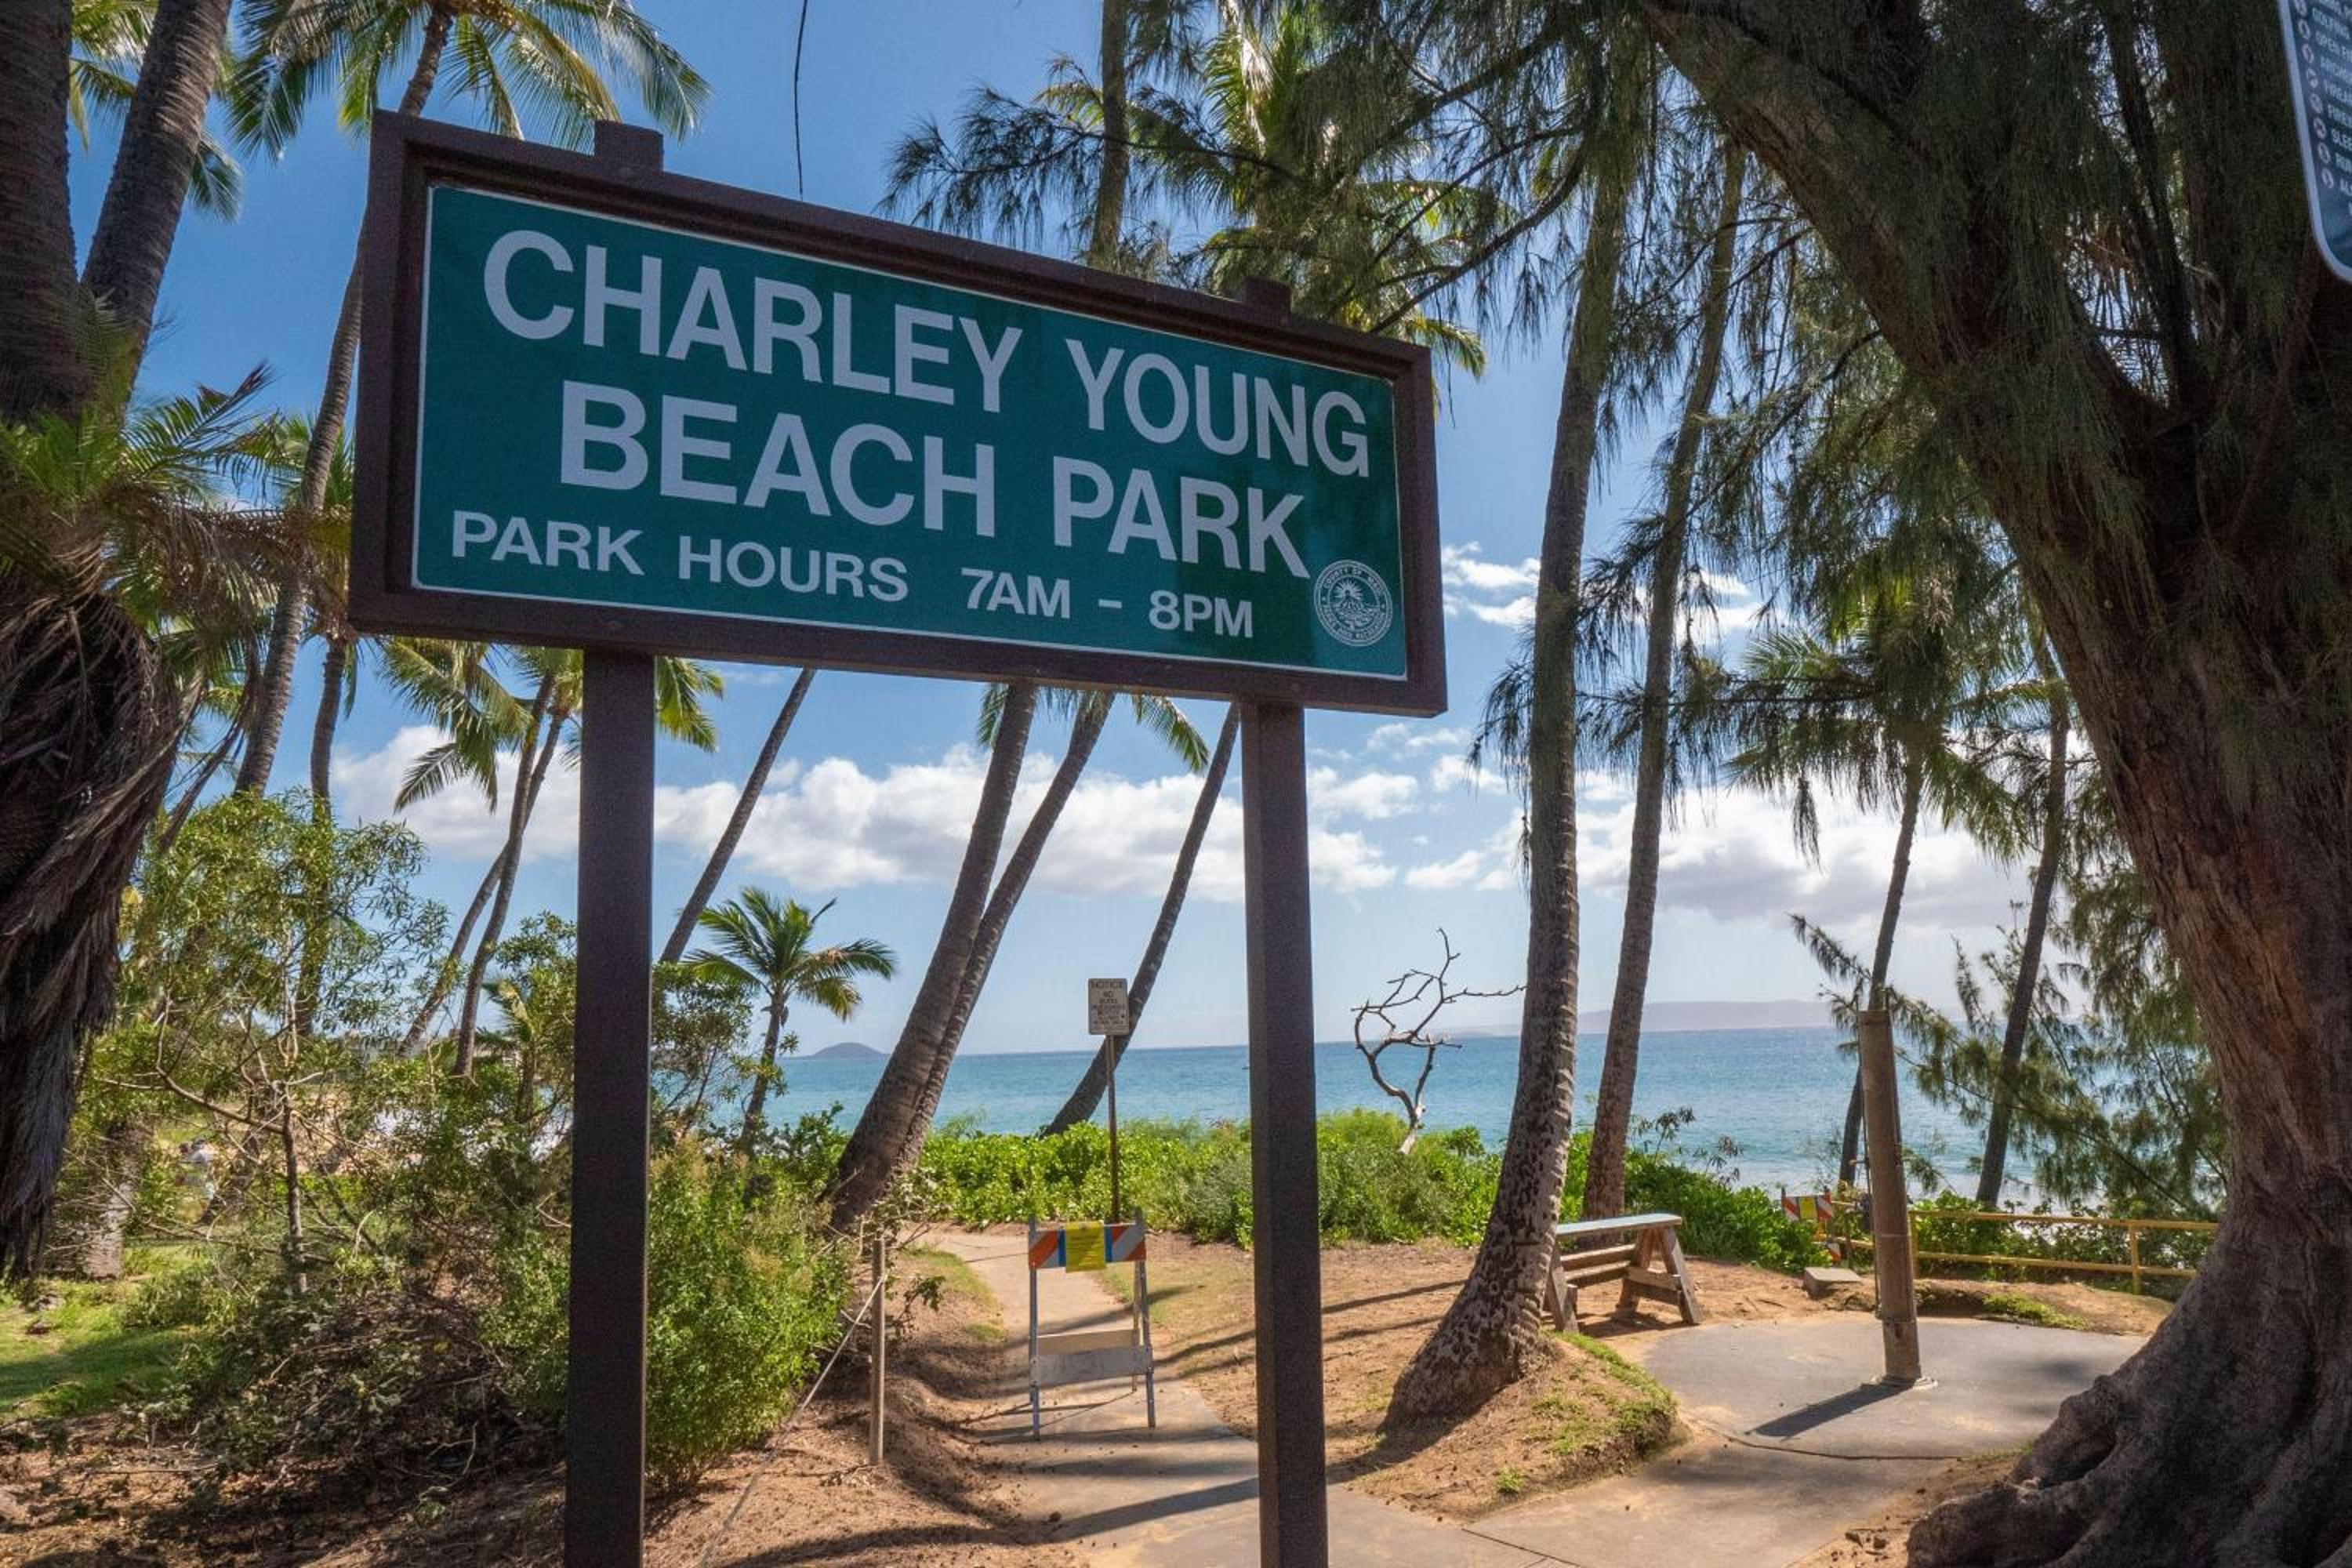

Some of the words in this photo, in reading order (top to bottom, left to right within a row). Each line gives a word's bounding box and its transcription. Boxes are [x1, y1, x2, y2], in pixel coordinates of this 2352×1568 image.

[484, 230, 1023, 412] CHARLEY
[1065, 338, 1369, 477] YOUNG
[452, 510, 644, 575] PARK
[679, 535, 908, 602] HOURS
[961, 568, 1070, 619] 7AM
[1149, 590, 1253, 637] 8PM
[561, 380, 995, 537] BEACH
[1053, 456, 1310, 579] PARK
